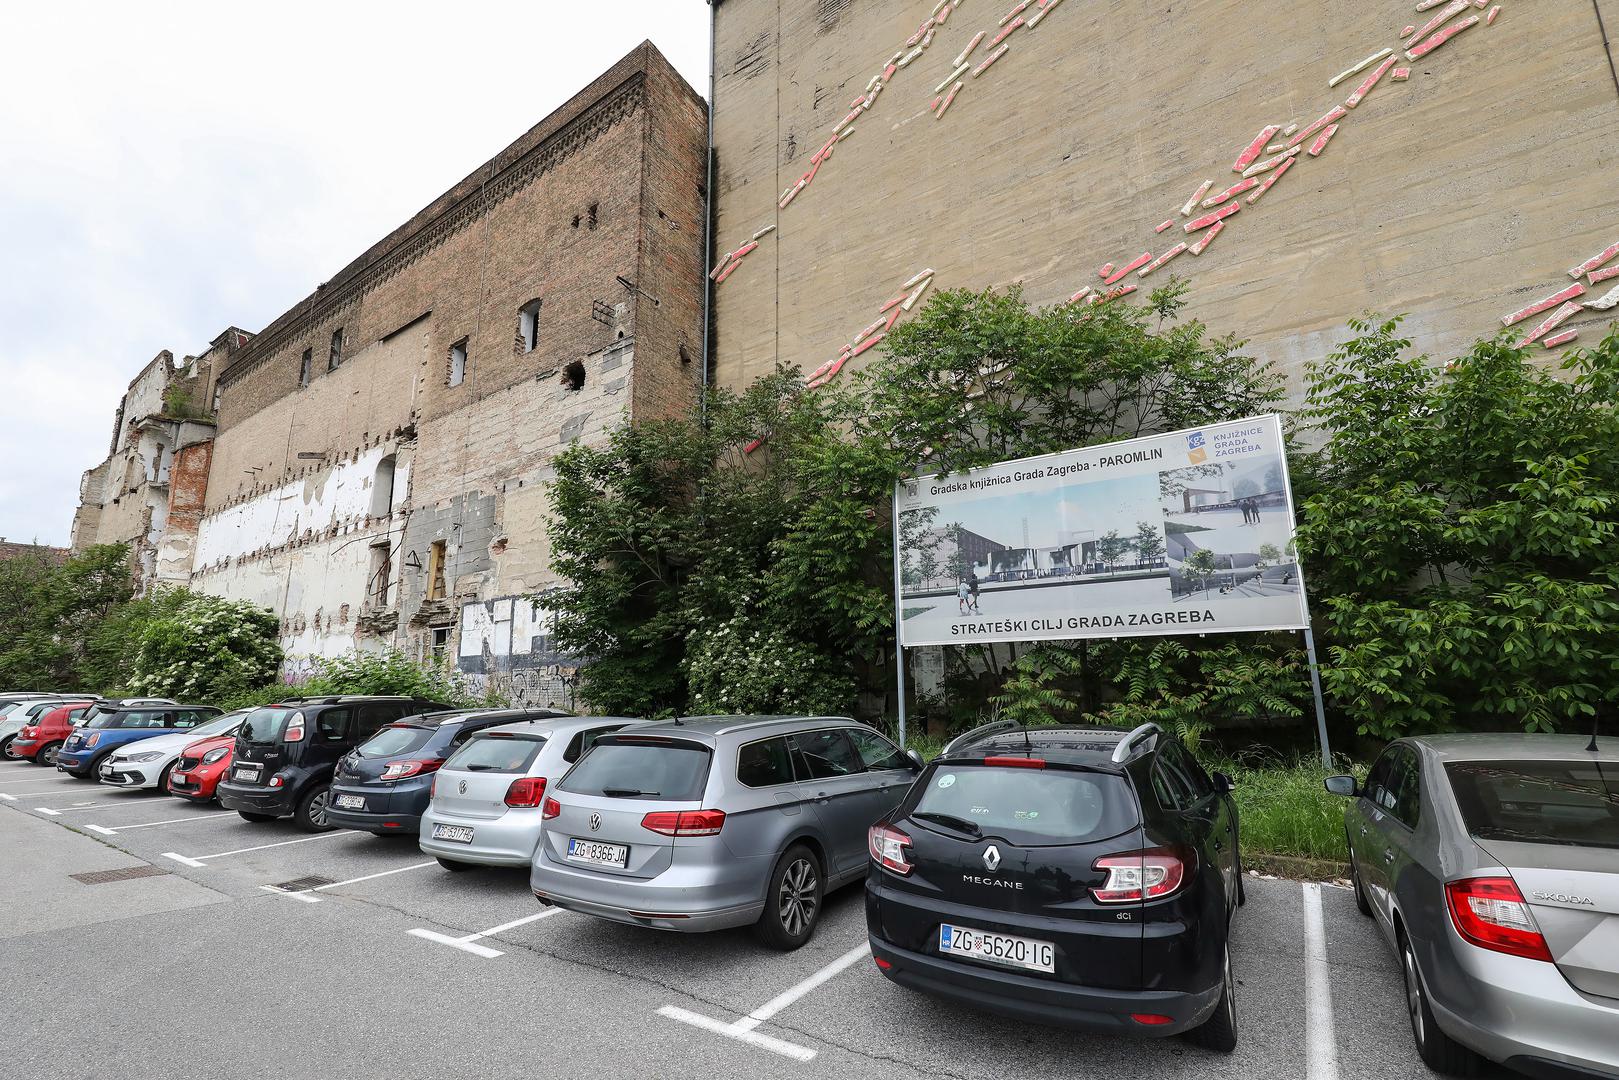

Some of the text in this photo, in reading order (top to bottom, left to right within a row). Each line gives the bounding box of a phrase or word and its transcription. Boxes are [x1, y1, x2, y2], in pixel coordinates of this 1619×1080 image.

[1214, 438, 1248, 449] GRADA
[1216, 444, 1261, 457] ZAGREBA
[930, 482, 967, 495] Gradska
[970, 475, 1011, 490] knjižnica
[1014, 468, 1044, 481] Grada
[1047, 462, 1090, 476] Zagreba
[1100, 448, 1163, 468] PAROMLIN
[951, 610, 1215, 634] STRATEŠKI CILJ GRADA ZAGREBA
[575, 842, 586, 857] ZG
[963, 874, 1024, 890] MEGANE
[1116, 912, 1132, 921] dCi
[953, 930, 972, 951] ZG
